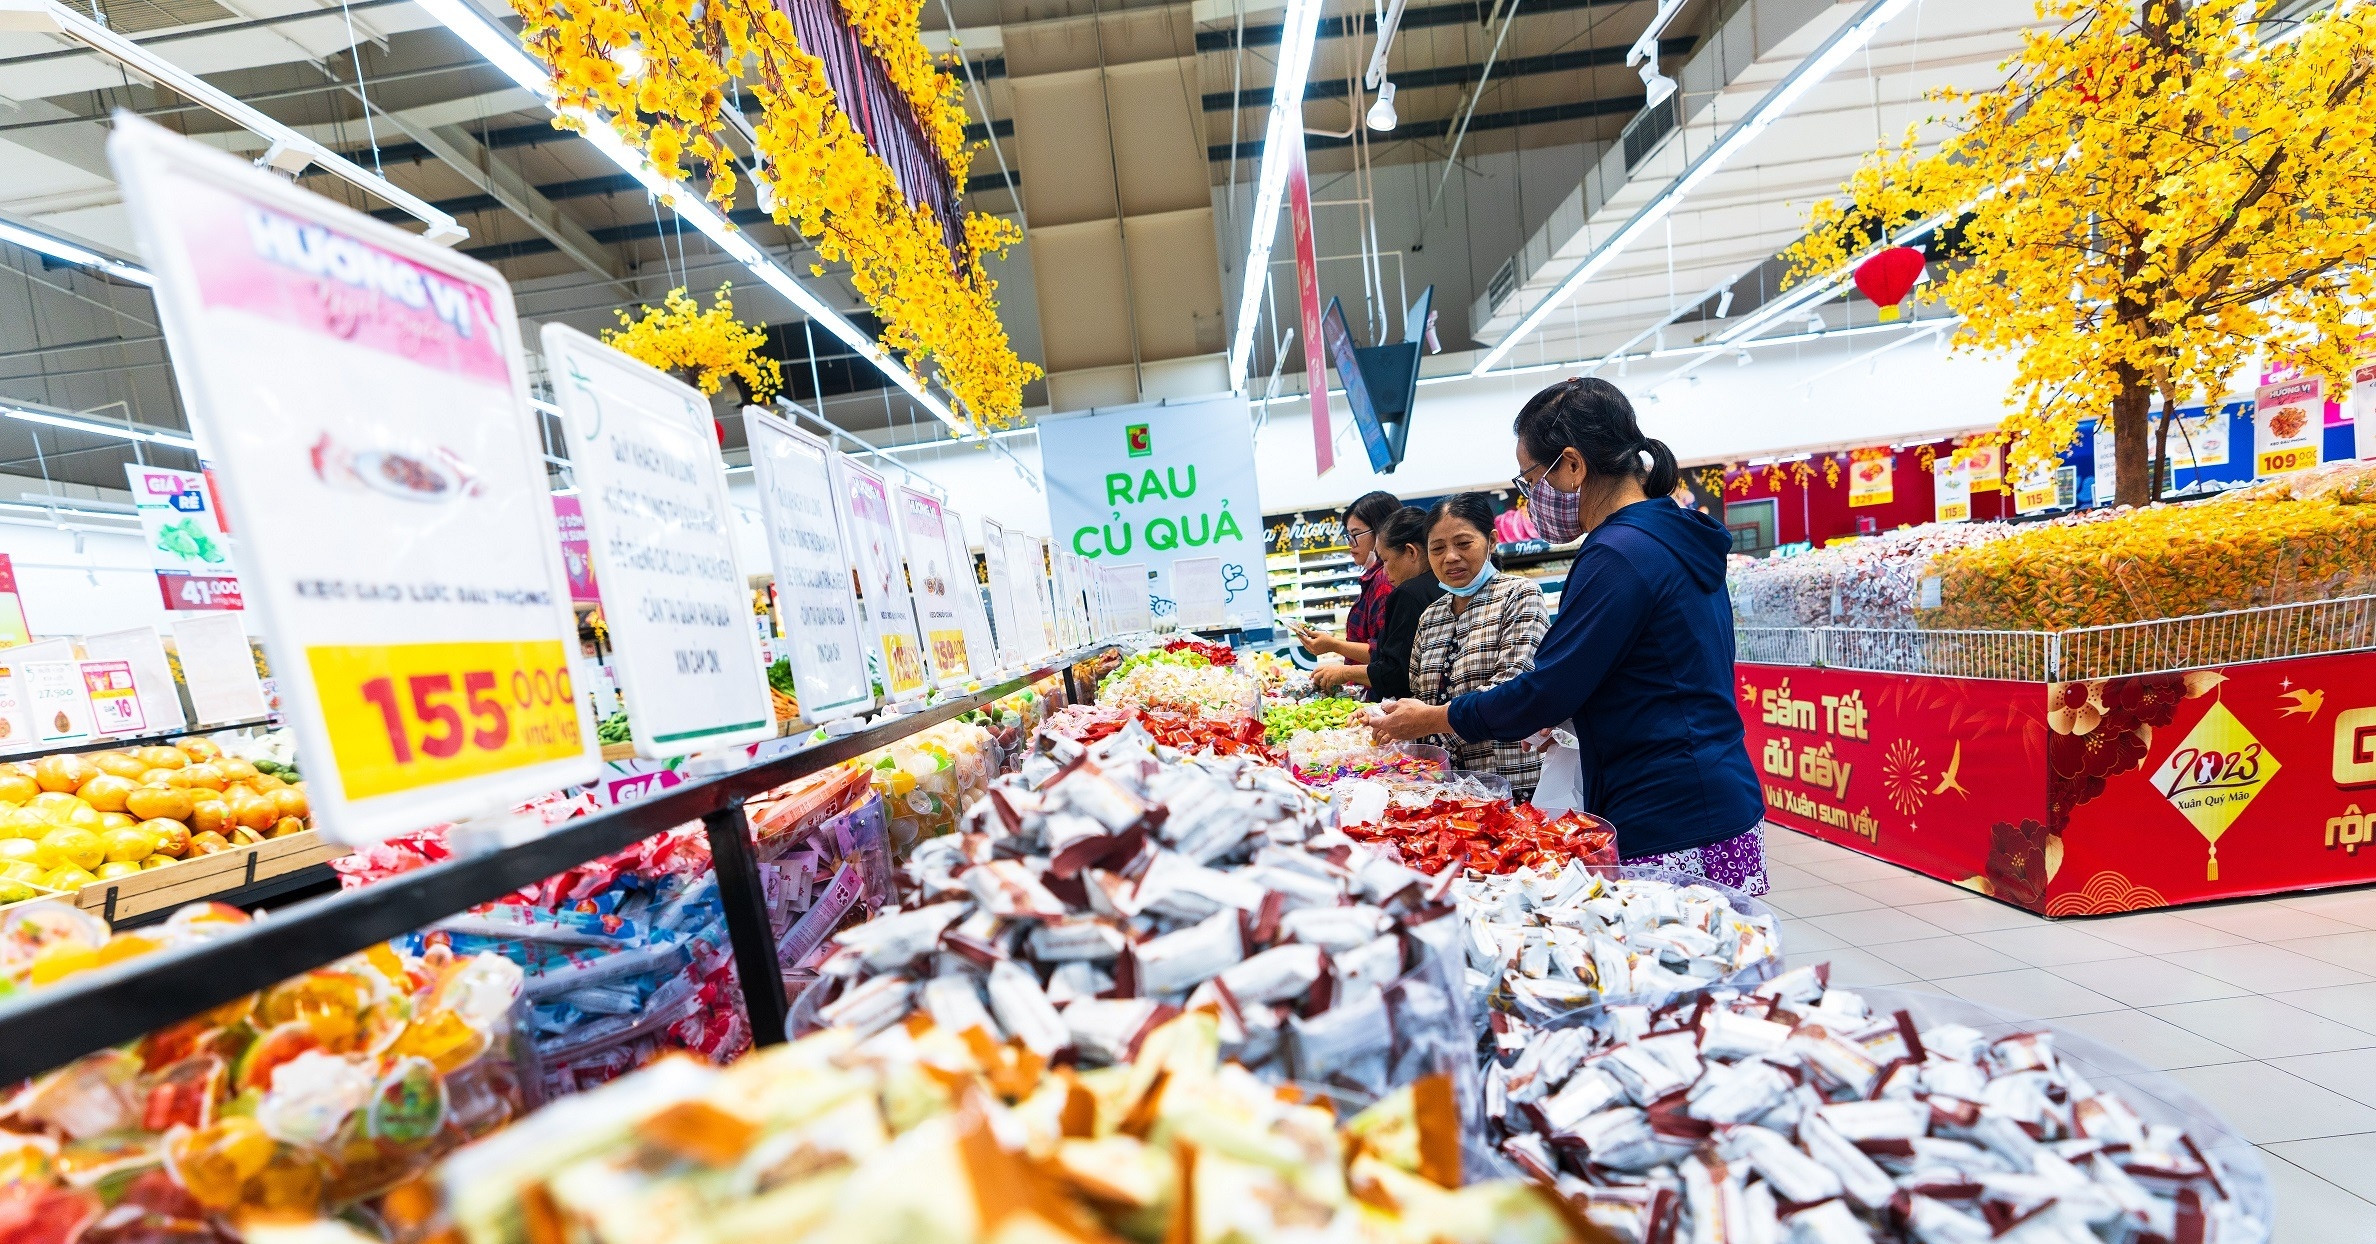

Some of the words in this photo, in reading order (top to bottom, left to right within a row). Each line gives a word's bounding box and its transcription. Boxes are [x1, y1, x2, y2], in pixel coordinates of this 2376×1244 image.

[147, 475, 179, 494] GIÁ
[1105, 464, 1197, 507] RAU
[1072, 511, 1132, 559] CỦ
[1144, 498, 1243, 552] QUẢ
[1762, 676, 1817, 732] Sắm
[1821, 688, 1869, 741] Tết
[1763, 736, 1794, 778] đủ
[1800, 741, 1852, 800] đầy
[2166, 742, 2263, 800] 2023
[1764, 784, 1784, 809] Vui
[1784, 792, 1818, 820] Xuân
[1818, 803, 1849, 829] sum
[1850, 805, 1880, 844] vầy
[2177, 797, 2202, 811] Xuân
[2204, 793, 2226, 807] Quý
[2228, 790, 2250, 802] Mão
